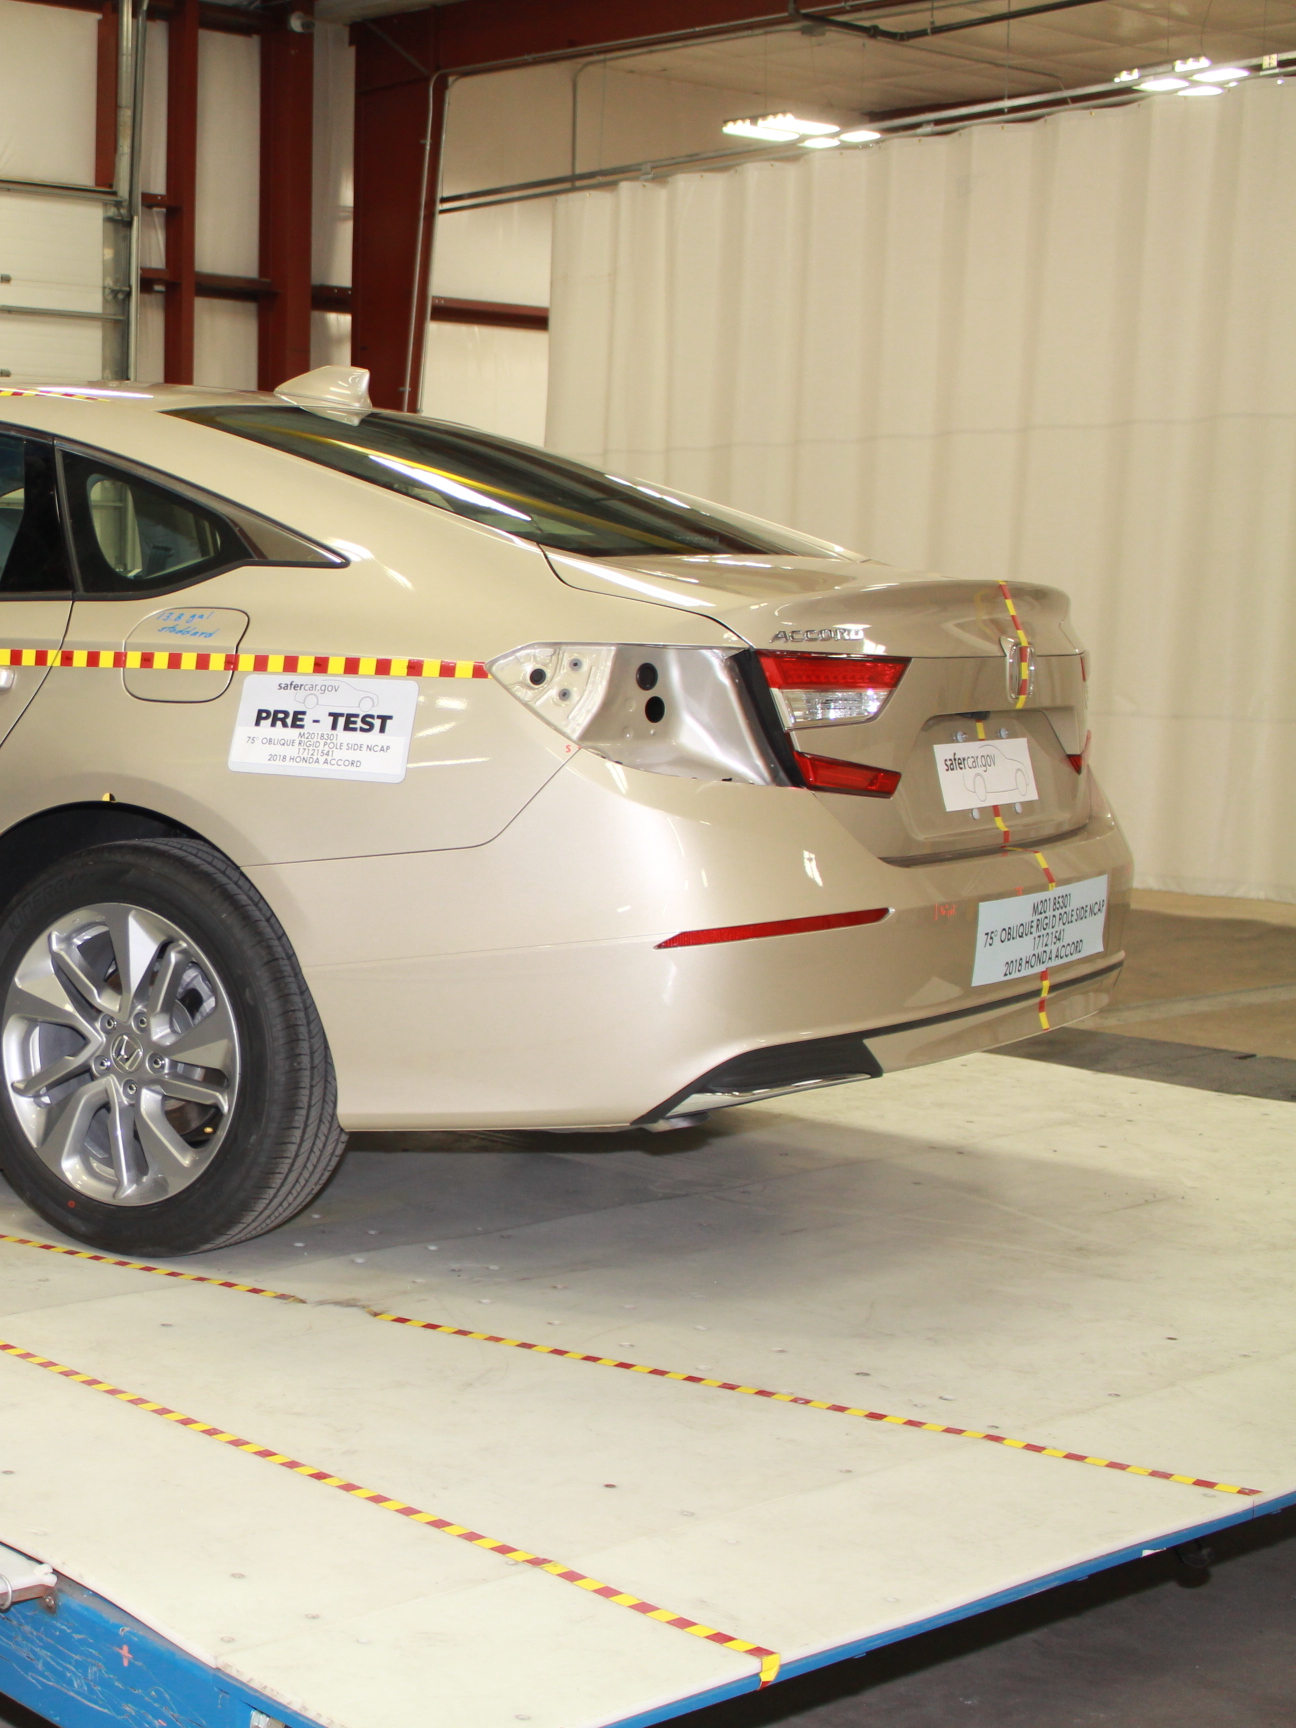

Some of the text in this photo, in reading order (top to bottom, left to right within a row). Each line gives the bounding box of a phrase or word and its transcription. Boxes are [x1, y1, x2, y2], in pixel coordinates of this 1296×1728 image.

[769, 629, 864, 643] ACCORD
[277, 681, 340, 694] safercar.gov
[328, 712, 394, 733] TEST
[261, 737, 296, 747] OBLIQUE
[297, 740, 321, 749] RIGID
[323, 741, 344, 750] POLE
[346, 742, 364, 752] SIDE
[366, 744, 391, 753] NCAP
[267, 753, 362, 768] 2018 HONDA ACCORD
[944, 752, 995, 772] safercar.gov
[999, 920, 1034, 943] OBLIQUE
[1058, 909, 1074, 927] POLE
[1075, 904, 1088, 922] SIDE
[1089, 899, 1105, 917] NCAP
[1003, 939, 1083, 977] 2018 HONDA ACCORD
